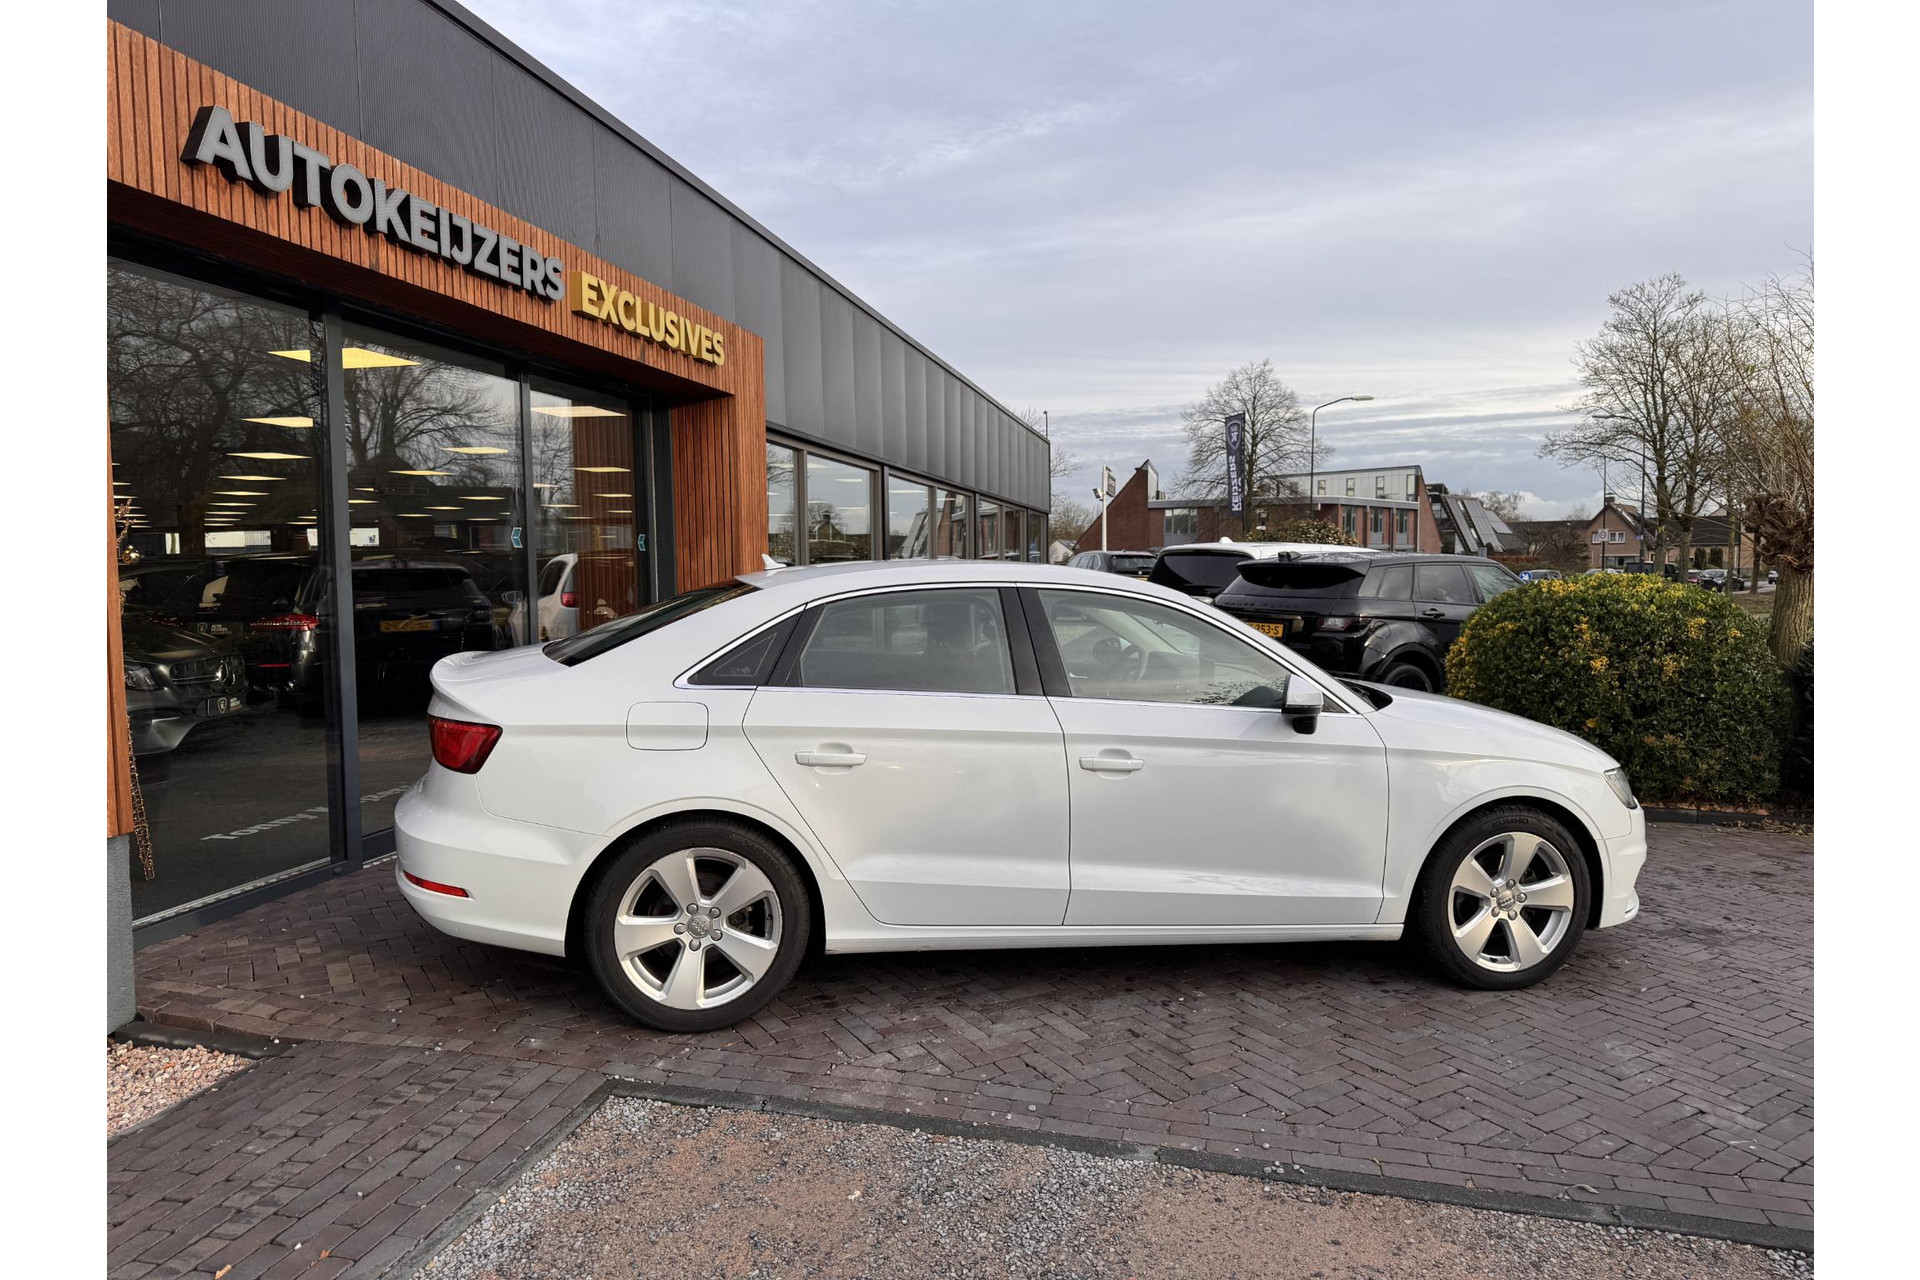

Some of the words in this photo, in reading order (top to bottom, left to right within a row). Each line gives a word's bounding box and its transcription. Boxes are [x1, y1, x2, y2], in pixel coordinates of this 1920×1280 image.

[188, 104, 566, 302] AUTOKEIJZERS
[578, 270, 725, 366] EXCLUSIVES
[1492, 818, 1529, 827] KUMHO
